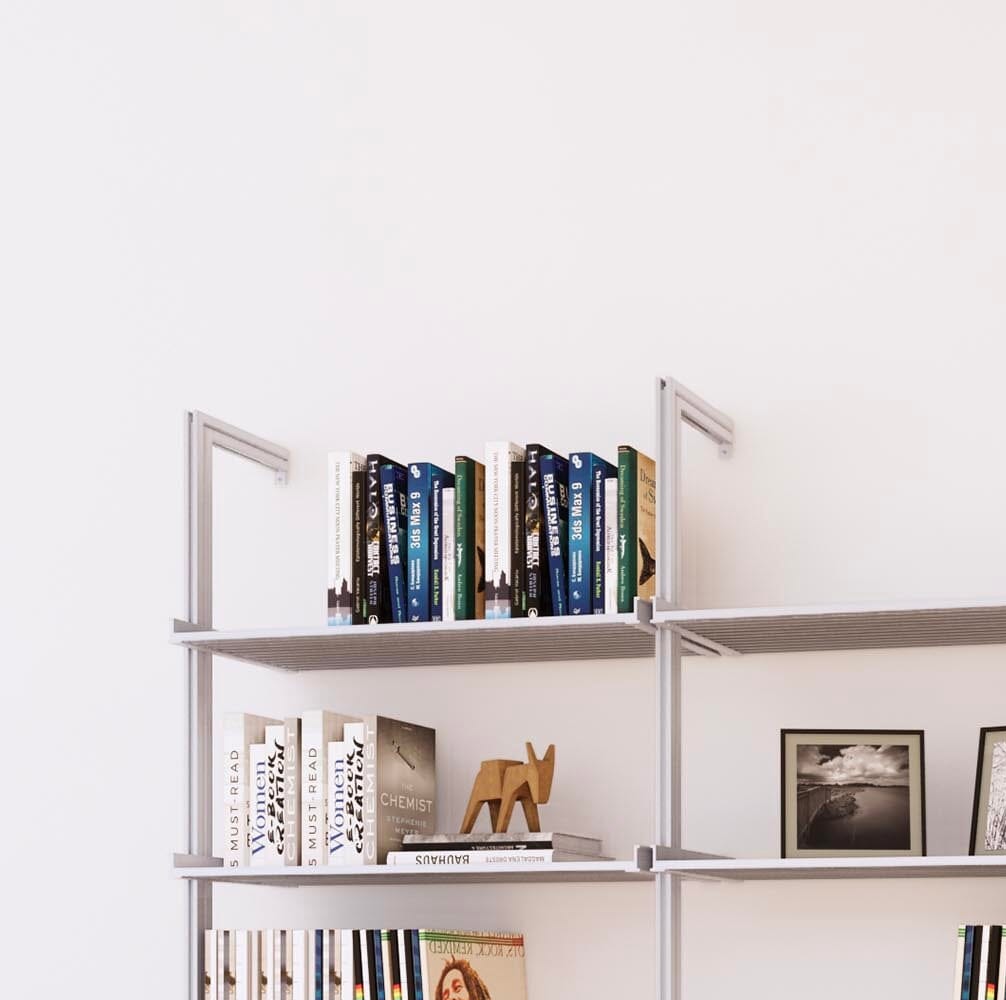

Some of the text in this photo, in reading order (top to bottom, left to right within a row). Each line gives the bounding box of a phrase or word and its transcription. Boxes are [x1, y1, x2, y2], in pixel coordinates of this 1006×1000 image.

[368, 460, 378, 519] HALO
[388, 483, 400, 564] BUSINESS
[411, 502, 420, 526] Max
[528, 450, 538, 510] HALO
[548, 474, 560, 556] BUSINESS
[572, 492, 582, 517] Max
[411, 528, 420, 548] 3ds
[572, 520, 582, 540] 3ds
[230, 750, 239, 850] MUST-READ
[252, 761, 266, 855] Women
[267, 752, 277, 844] E-BOOK
[274, 738, 284, 855] CREATION
[287, 727, 296, 860] CHEMIST
[309, 748, 317, 866] 5 MUST-READ
[330, 760, 344, 855] Women
[346, 749, 355, 842] E-BOOK
[353, 736, 364, 854] CREATION
[366, 725, 375, 860] CHEMIST
[380, 793, 432, 812] CHEMIST
[415, 854, 470, 865] BAUHAUS
